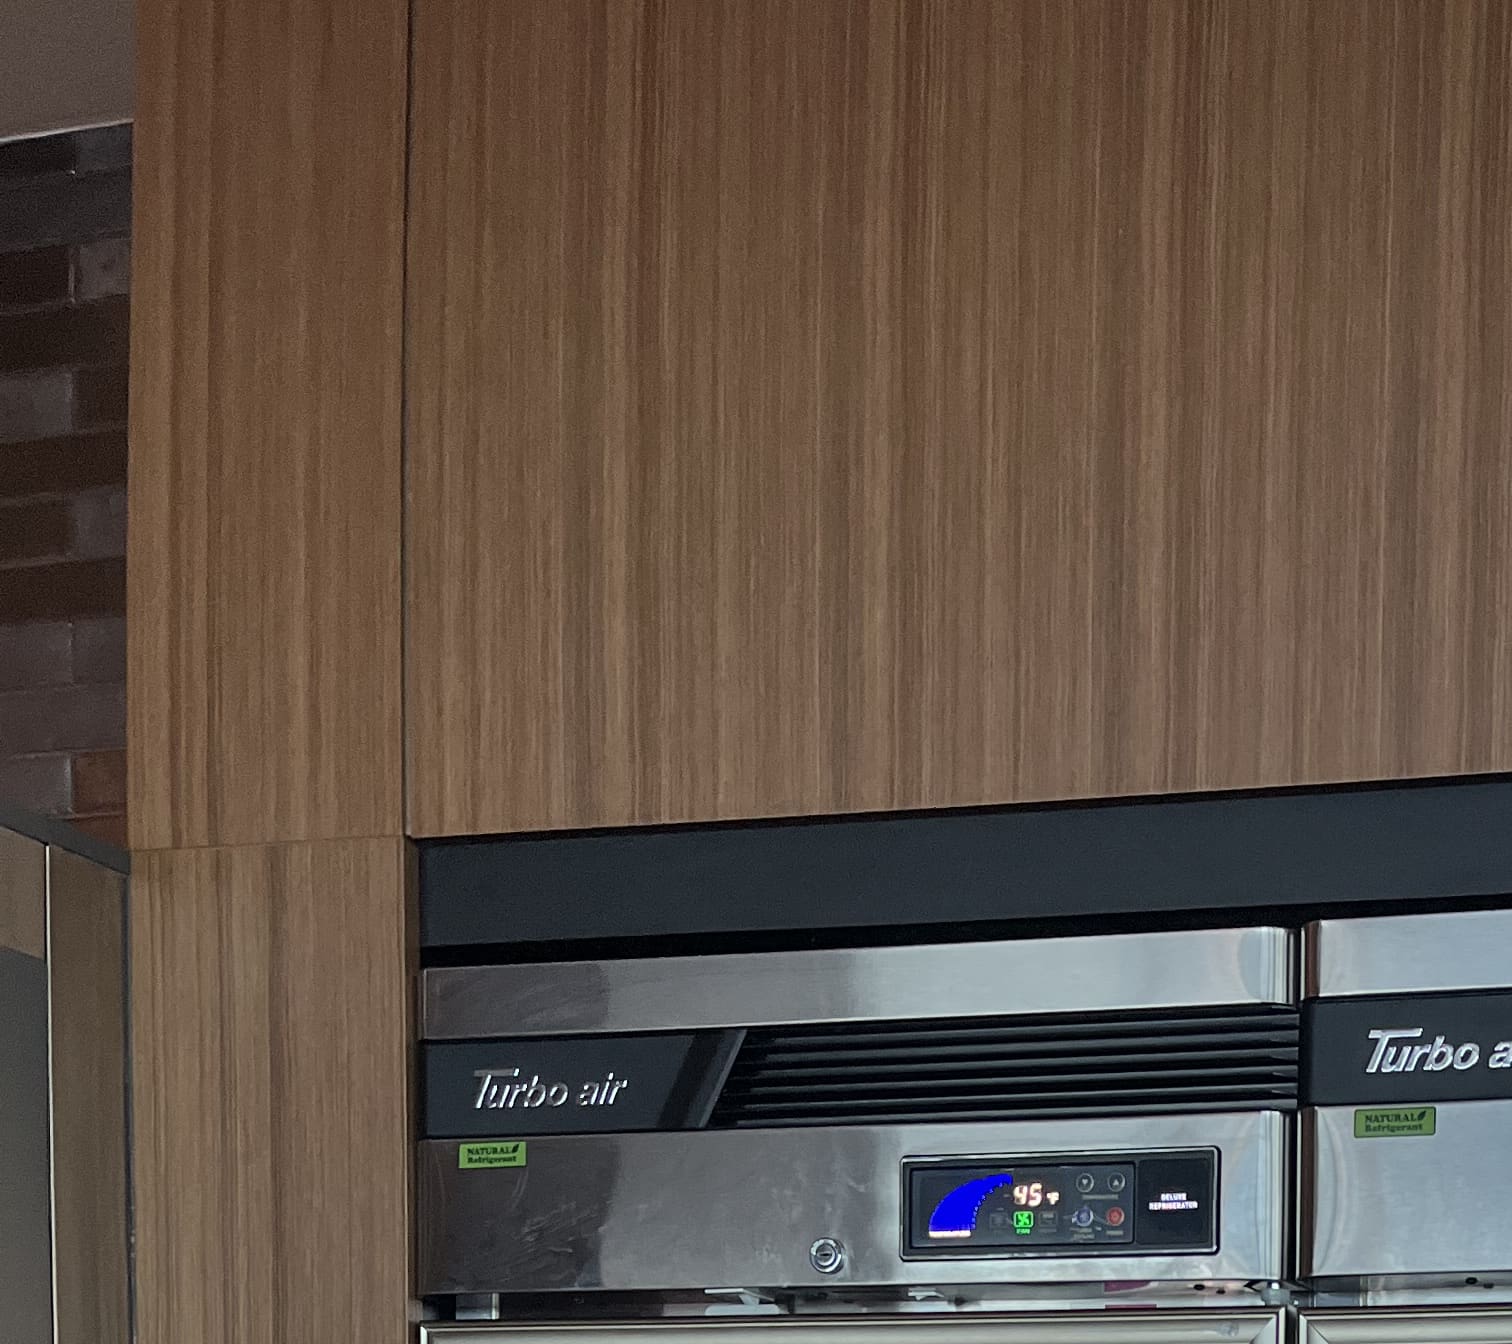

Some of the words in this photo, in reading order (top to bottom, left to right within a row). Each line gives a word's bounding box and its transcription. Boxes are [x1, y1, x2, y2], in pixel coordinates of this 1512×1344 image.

[1366, 1028, 1480, 1073] Turbo
[473, 1068, 568, 1109] Turbo
[580, 1073, 627, 1106] air
[1365, 1113, 1417, 1124] NATURAL
[467, 1147, 511, 1155] NATURAL
